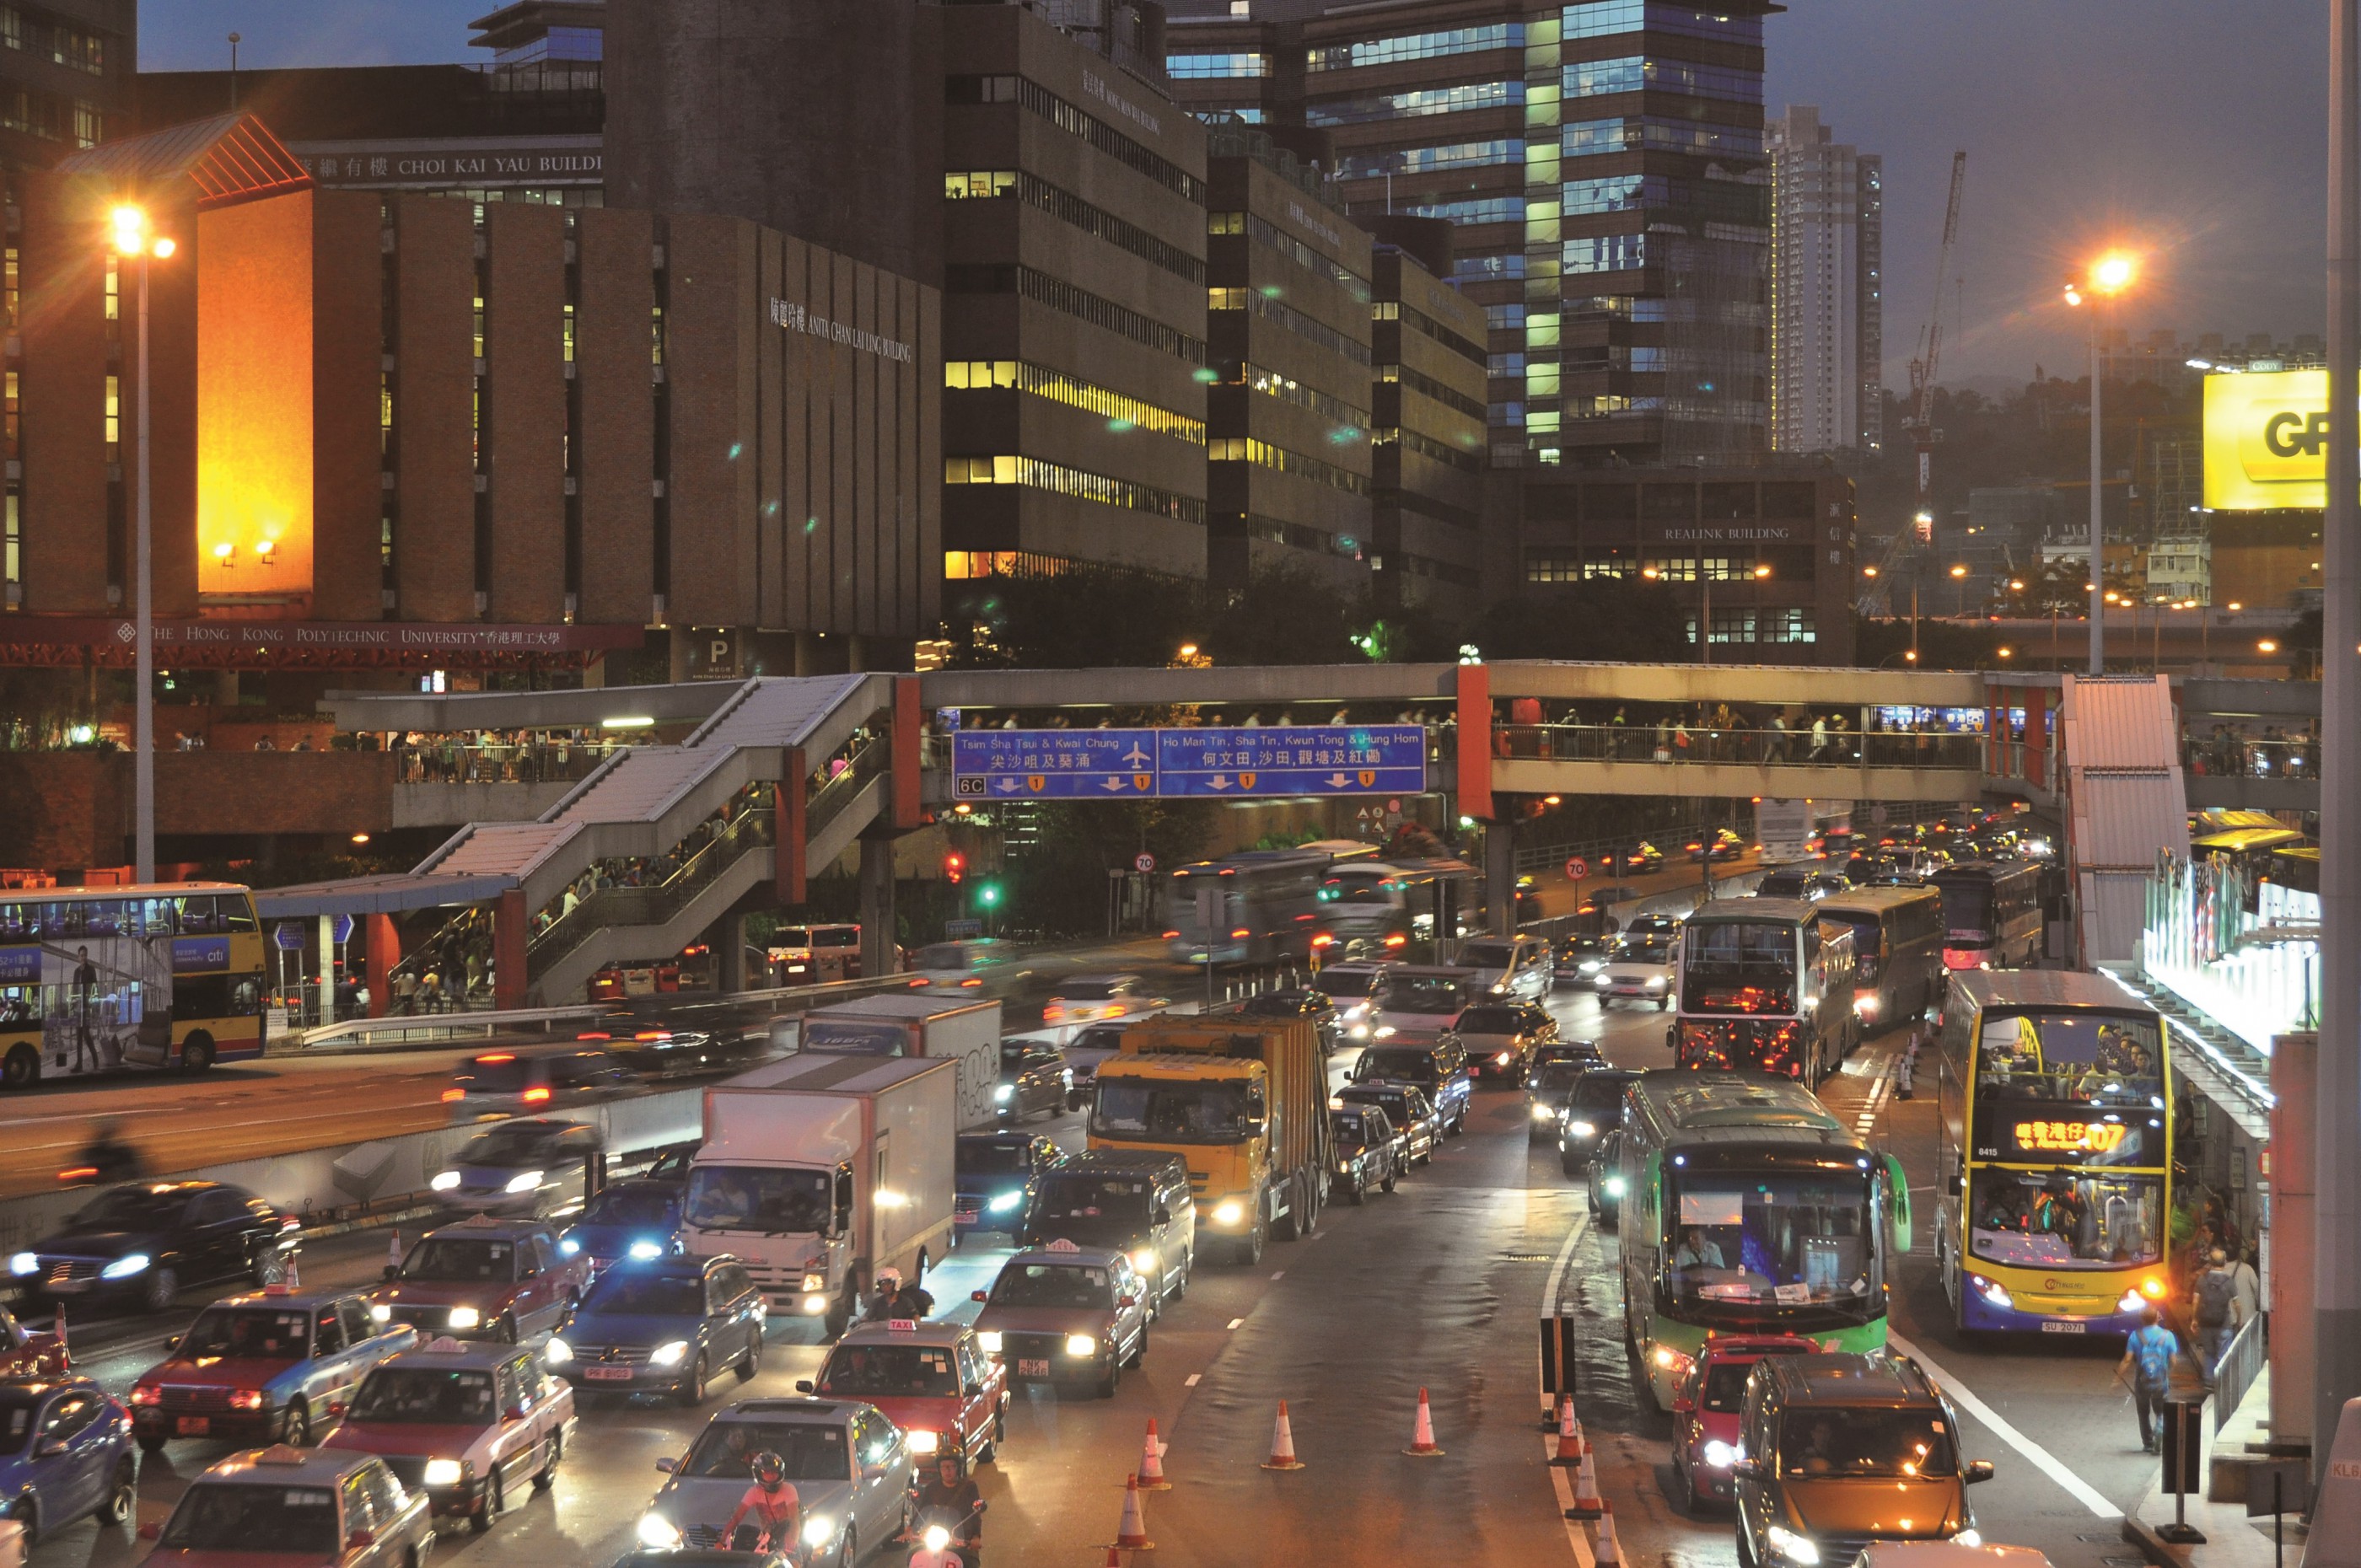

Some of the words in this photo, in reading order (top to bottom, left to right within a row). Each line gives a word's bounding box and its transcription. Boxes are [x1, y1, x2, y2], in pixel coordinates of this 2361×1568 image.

[399, 159, 446, 175] CHOI
[454, 158, 486, 173] KAI
[495, 158, 530, 172] YAU
[540, 156, 602, 171] BUILDI
[808, 314, 829, 340] ANITA
[831, 321, 851, 345] CHAN
[852, 328, 864, 351] LAI
[866, 332, 881, 356] LING
[883, 338, 911, 363] BUILDING
[2252, 362, 2278, 371] CODY
[1665, 529, 1723, 540] REALINK
[1729, 528, 1789, 538] BUILDING
[150, 626, 175, 640] HE
[186, 626, 229, 641] HONG
[242, 627, 284, 642] KONG
[297, 627, 390, 643] POLYTECHNIC
[401, 630, 477, 644] UNIVERSITY
[486, 631, 561, 645] 香港理工大學
[712, 641, 728, 663] P
[961, 739, 986, 749] Tsim
[991, 738, 1011, 749] Sha
[1016, 738, 1037, 749] Tsui
[1042, 738, 1050, 749] &
[1056, 738, 1081, 749] Kwai
[1086, 738, 1119, 750] Chung
[1164, 738, 1179, 747] Ho
[1183, 737, 1206, 747] Man
[1210, 736, 1230, 748] Tin,
[1235, 736, 1256, 746] Sha
[1260, 735, 1281, 747] Tin,
[1285, 735, 1315, 746] Kwun
[1318, 735, 1344, 747] Tong
[1349, 734, 1357, 744] &
[1362, 733, 1390, 746] Hung
[1394, 733, 1419, 744] Hom
[991, 753, 1090, 769] 尖沙咀及葵涌
[1034, 778, 1039, 788] 1
[1139, 777, 1144, 787] 1
[1245, 776, 1250, 785] 1
[1363, 774, 1369, 783] 1
[960, 780, 982, 792] 6C
[1139, 858, 1153, 868] 70
[1569, 864, 1584, 875] 70
[207, 949, 223, 962] citi
